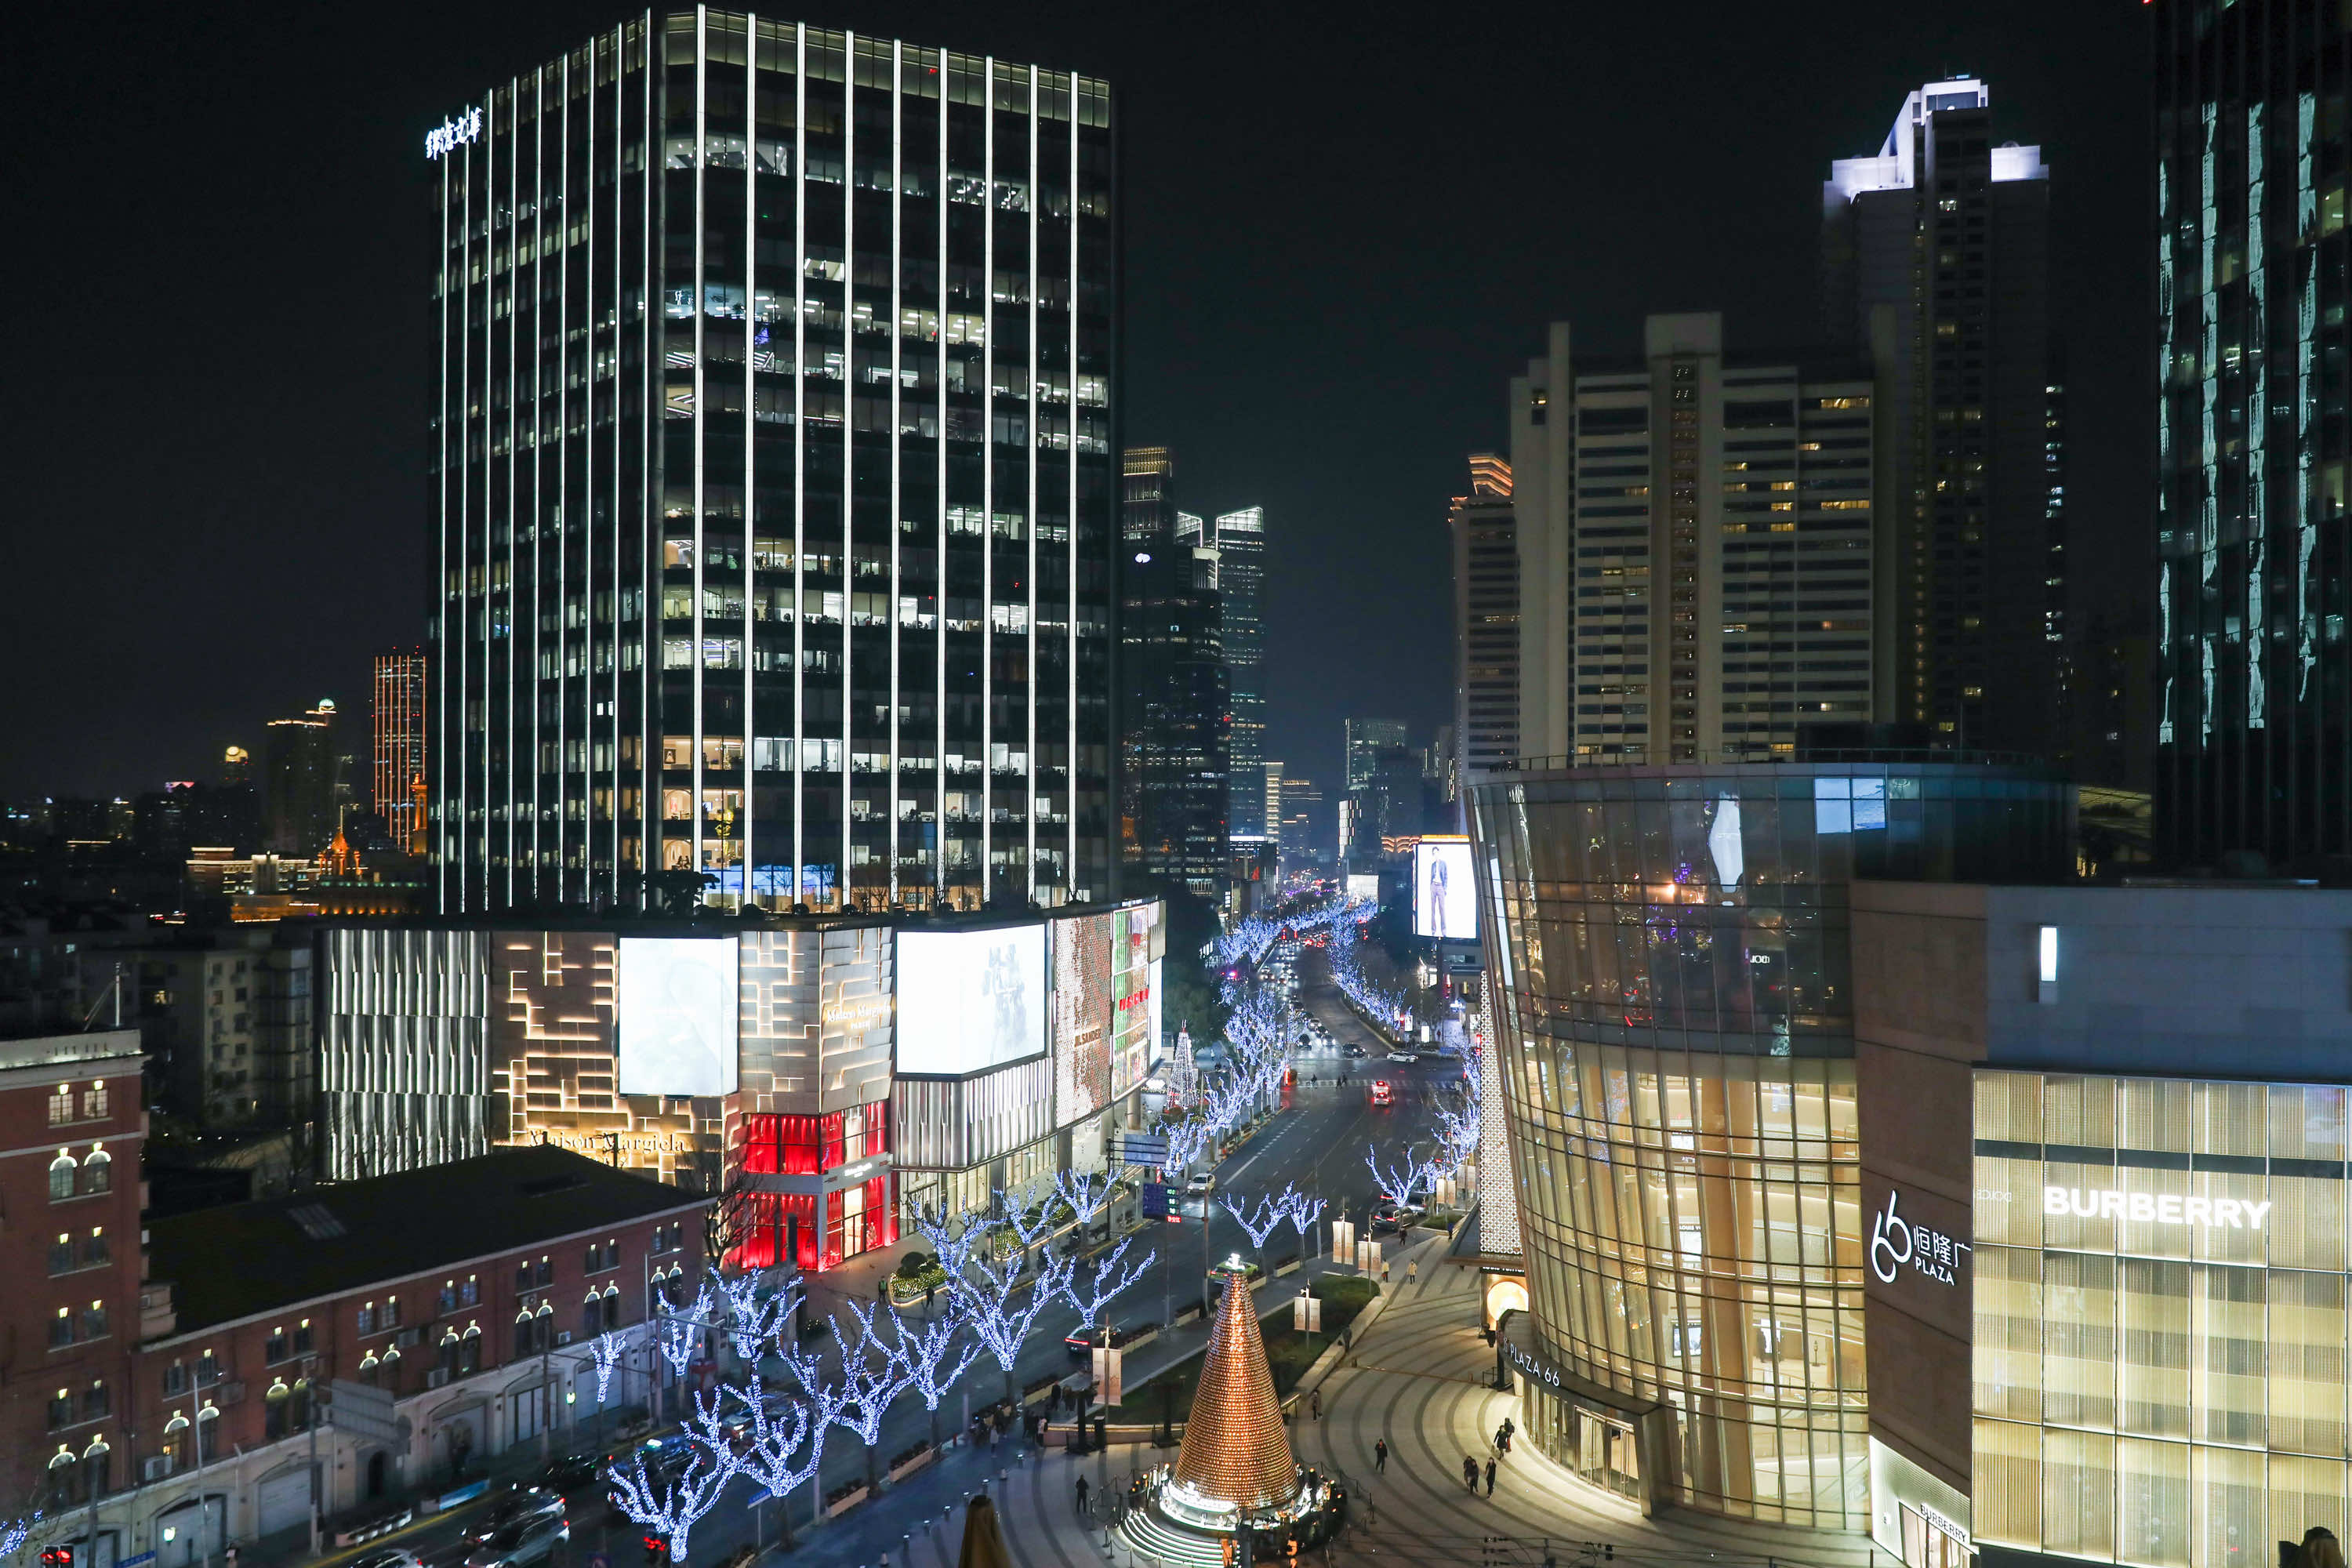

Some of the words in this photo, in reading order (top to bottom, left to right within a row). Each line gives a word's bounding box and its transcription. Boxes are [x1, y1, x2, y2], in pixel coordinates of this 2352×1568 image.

[2044, 1186, 2271, 1229] BURBERRY
[1914, 1225, 1972, 1269] 恒隆广
[1915, 1256, 1955, 1287] PLAZA
[1510, 1343, 1541, 1378] PLAZA
[1544, 1367, 1560, 1387] 66
[1920, 1504, 1966, 1542] BURBERRY
